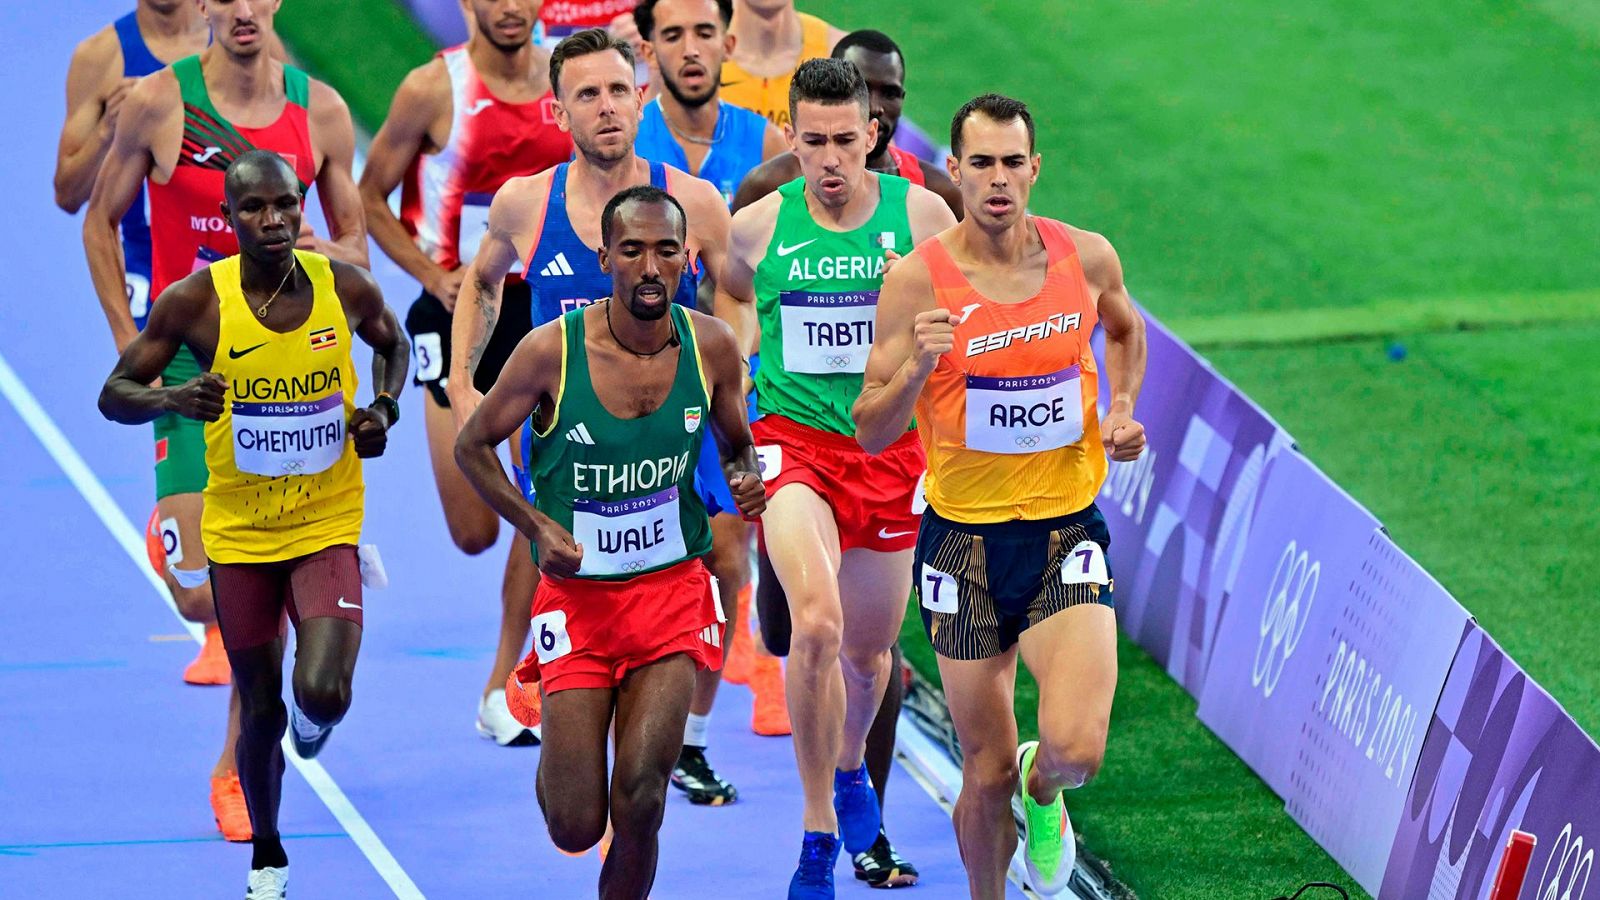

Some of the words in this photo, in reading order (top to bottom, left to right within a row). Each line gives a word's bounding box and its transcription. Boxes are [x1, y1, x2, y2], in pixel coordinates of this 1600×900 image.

[787, 256, 887, 281] ALGERIA
[807, 295, 835, 304] PARIS
[838, 294, 865, 304] 2024
[803, 320, 873, 347] TABTI
[965, 312, 1082, 358] ESPAÑA
[418, 345, 431, 370] 3
[233, 367, 342, 400] UGANDA
[998, 379, 1028, 388] PARIS
[1031, 376, 1056, 386] 2024
[293, 404, 320, 413] 2024
[989, 397, 1065, 428] ARCE
[237, 419, 341, 453] CHEMUTAI
[573, 450, 690, 494] ETHIOPIA
[601, 504, 629, 514] PARIS
[632, 498, 657, 510] 2024
[597, 518, 665, 554] WALE
[1074, 549, 1094, 574] 7
[926, 574, 943, 603] 7
[540, 622, 556, 652] 6
[1365, 684, 1418, 789] 2024
